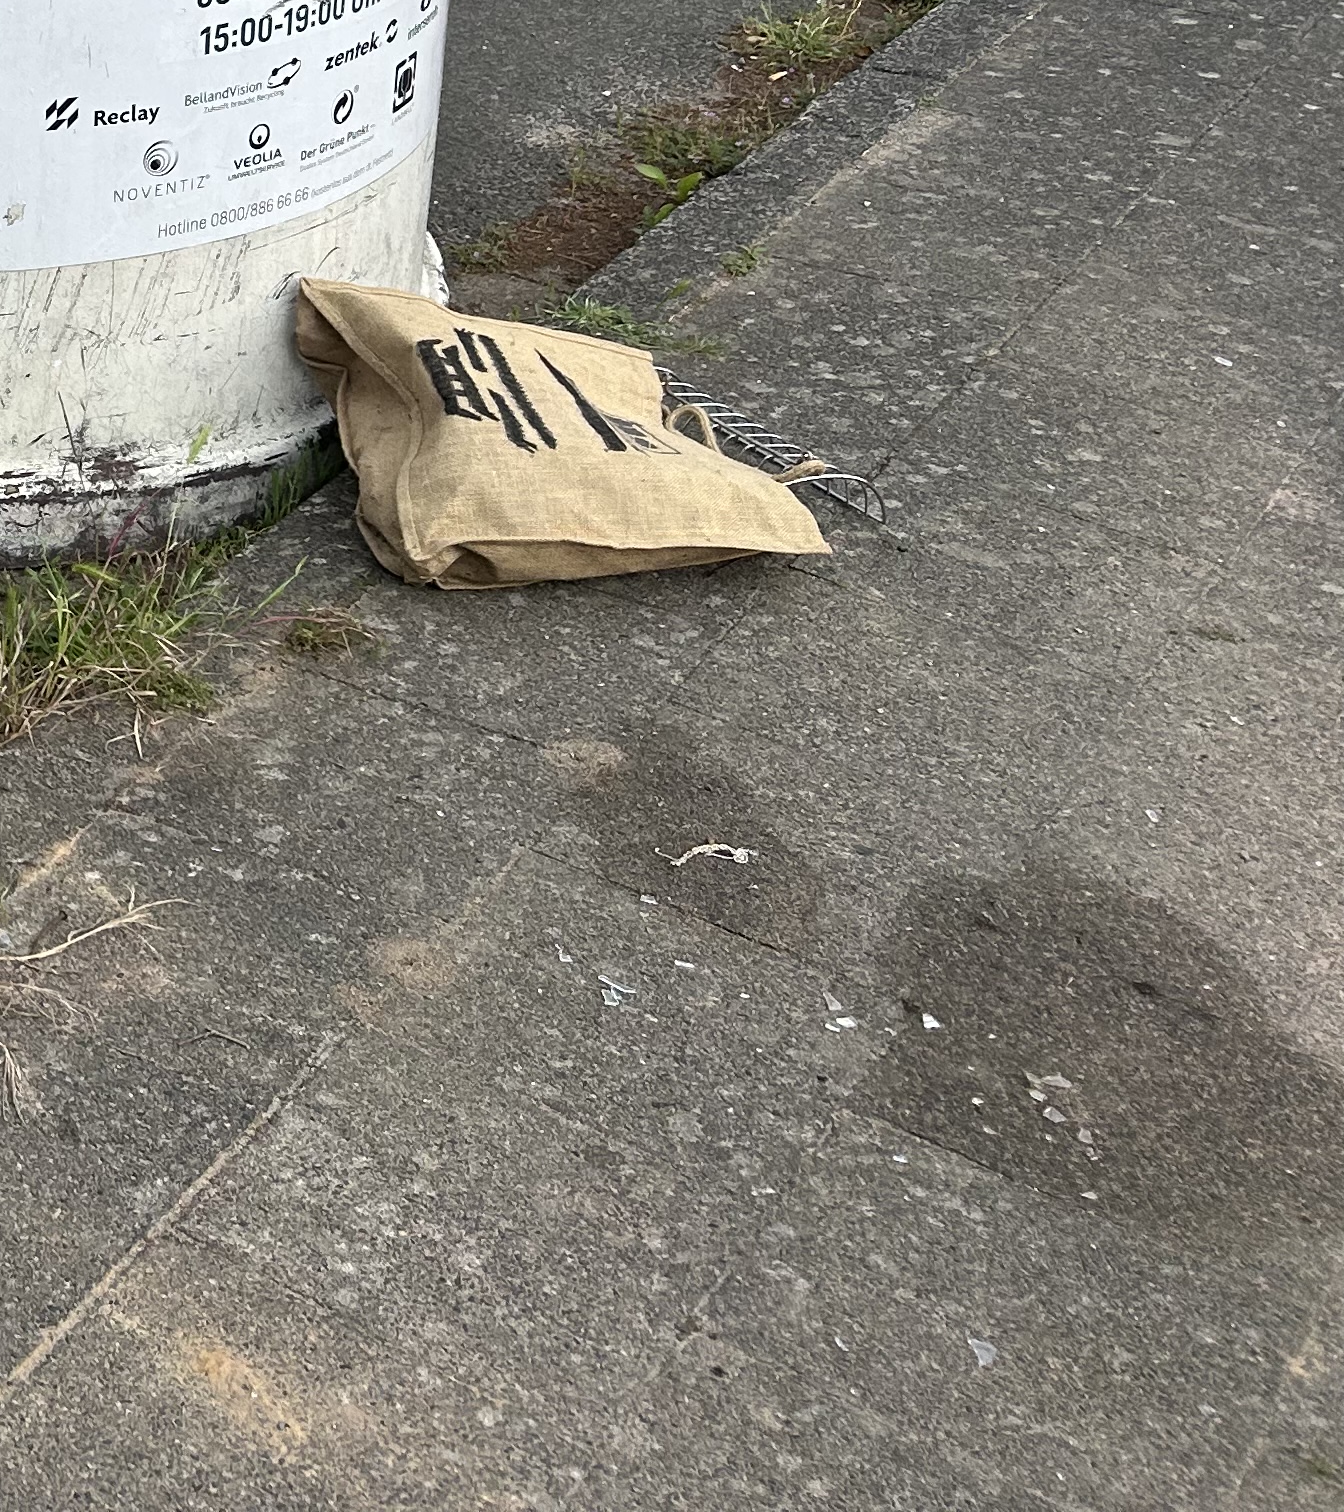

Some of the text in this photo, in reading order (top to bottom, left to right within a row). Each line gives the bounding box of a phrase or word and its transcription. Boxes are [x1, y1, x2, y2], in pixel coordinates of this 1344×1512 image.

[324, 31, 379, 71] zentek
[184, 82, 263, 107] BellandVision
[93, 103, 161, 127] Reclay
[233, 148, 283, 170] VEOLIA
[300, 148, 318, 161] Der
[157, 186, 310, 238] Hotline 0800/886 66 66
